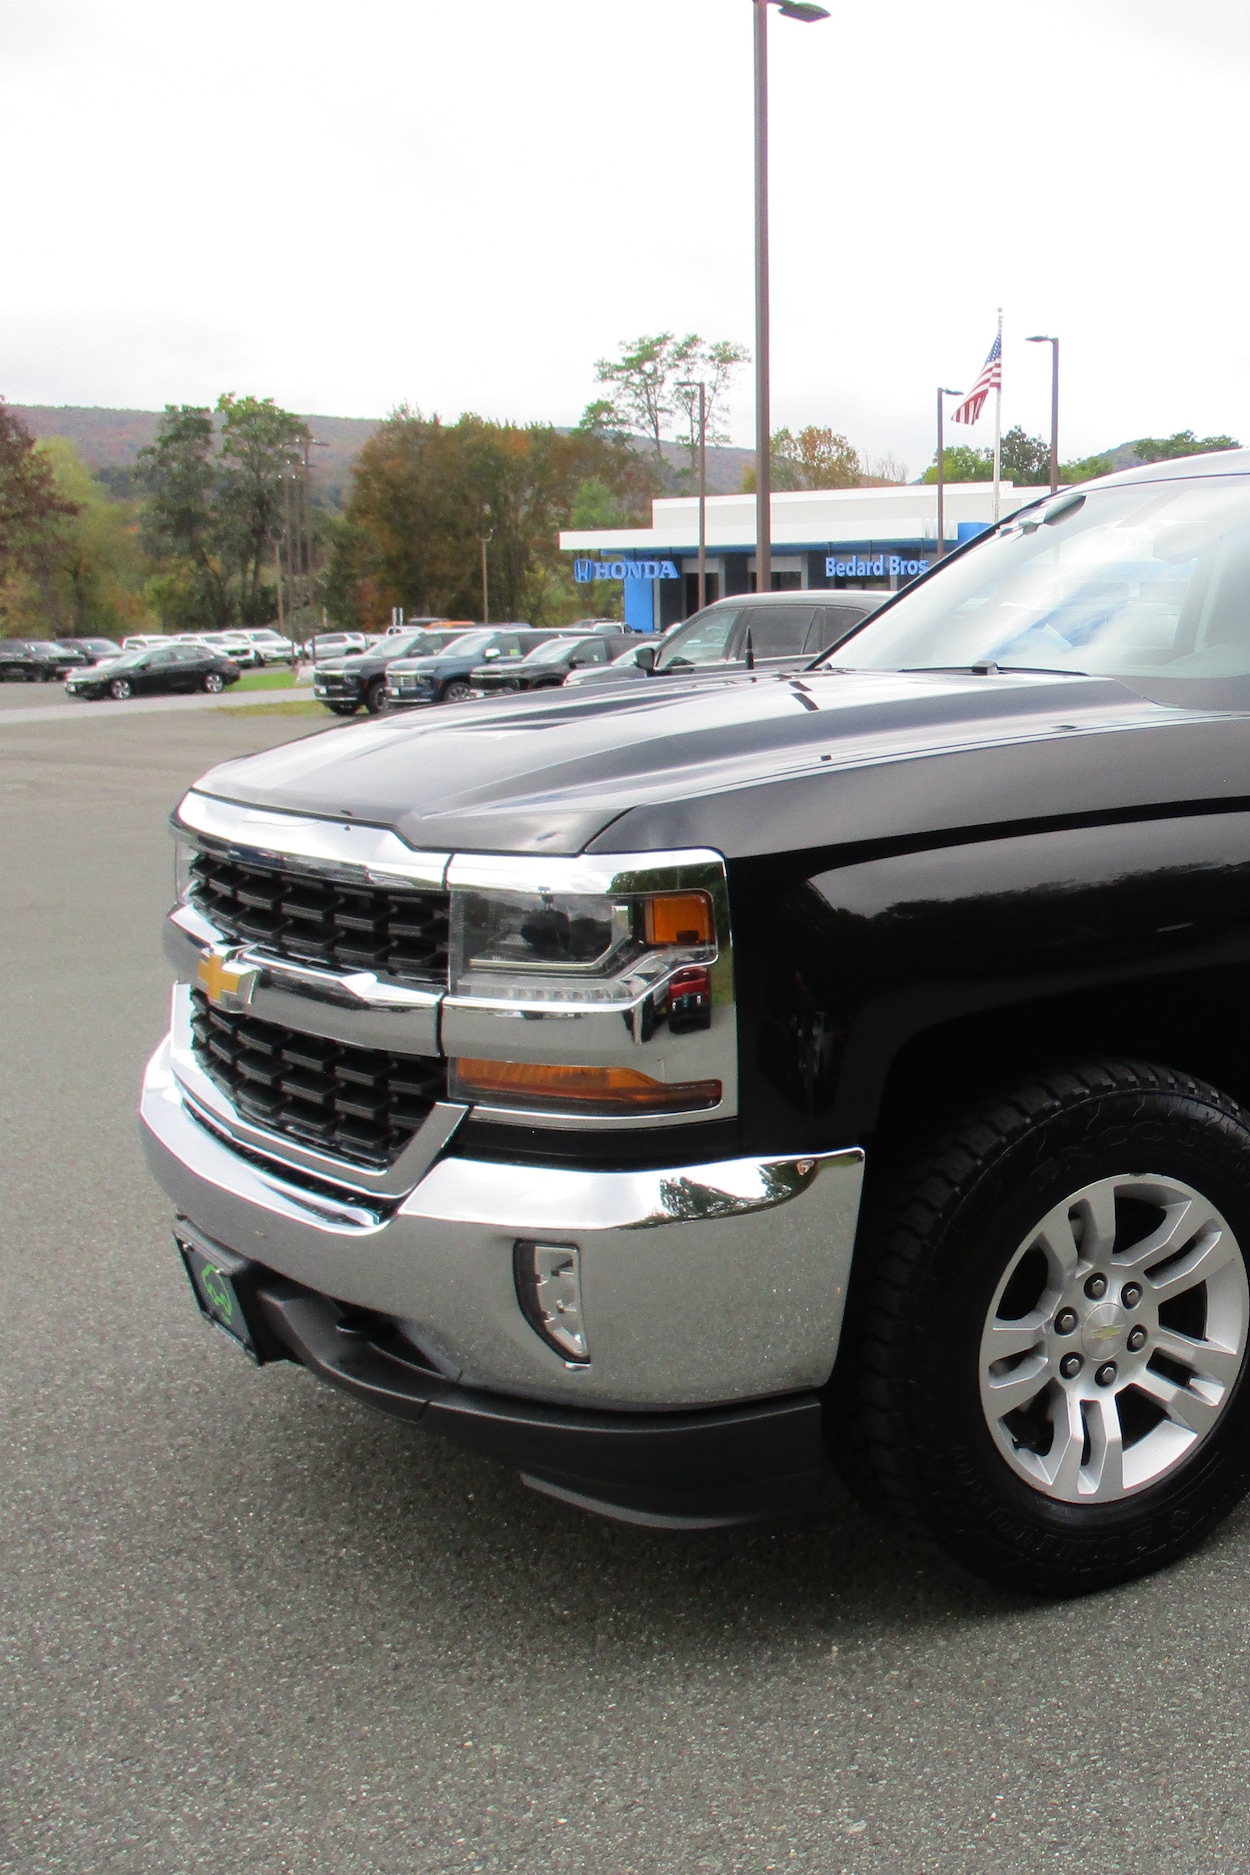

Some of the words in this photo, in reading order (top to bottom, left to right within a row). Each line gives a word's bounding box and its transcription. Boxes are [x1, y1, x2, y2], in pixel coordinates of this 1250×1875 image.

[593, 560, 680, 581] HONDA
[825, 555, 885, 578] Bedard
[888, 556, 929, 577] Bros
